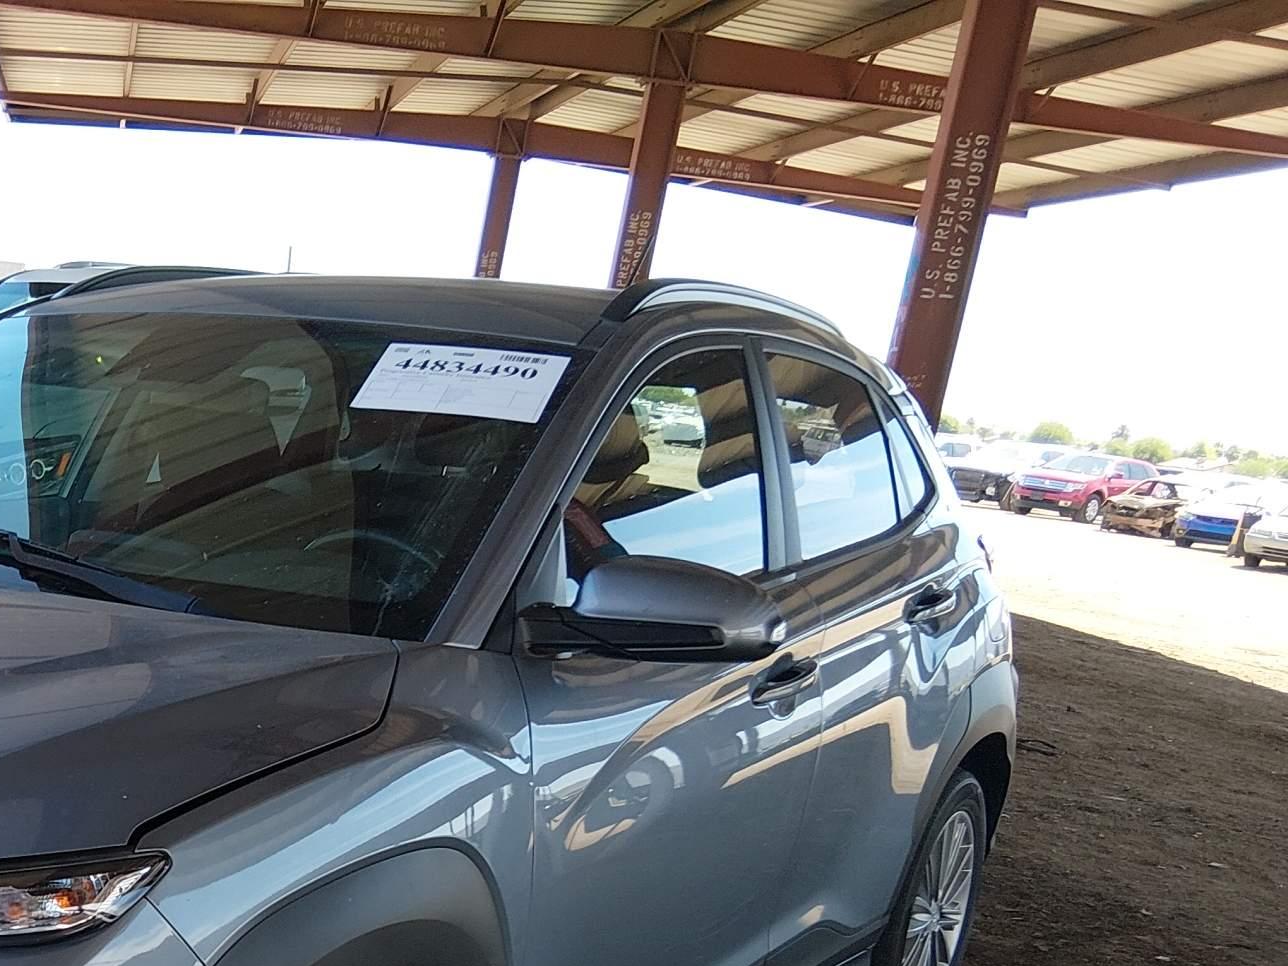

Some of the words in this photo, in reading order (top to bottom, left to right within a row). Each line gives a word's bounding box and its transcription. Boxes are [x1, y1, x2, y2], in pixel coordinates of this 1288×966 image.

[908, 83, 948, 98] PREFA
[950, 131, 974, 168] INC.
[931, 178, 962, 253] PREFAB
[938, 134, 991, 299] 1-866-799-0969
[615, 240, 635, 288] PREFAB
[920, 263, 943, 299] U.S.
[395, 357, 538, 380] 44834490
